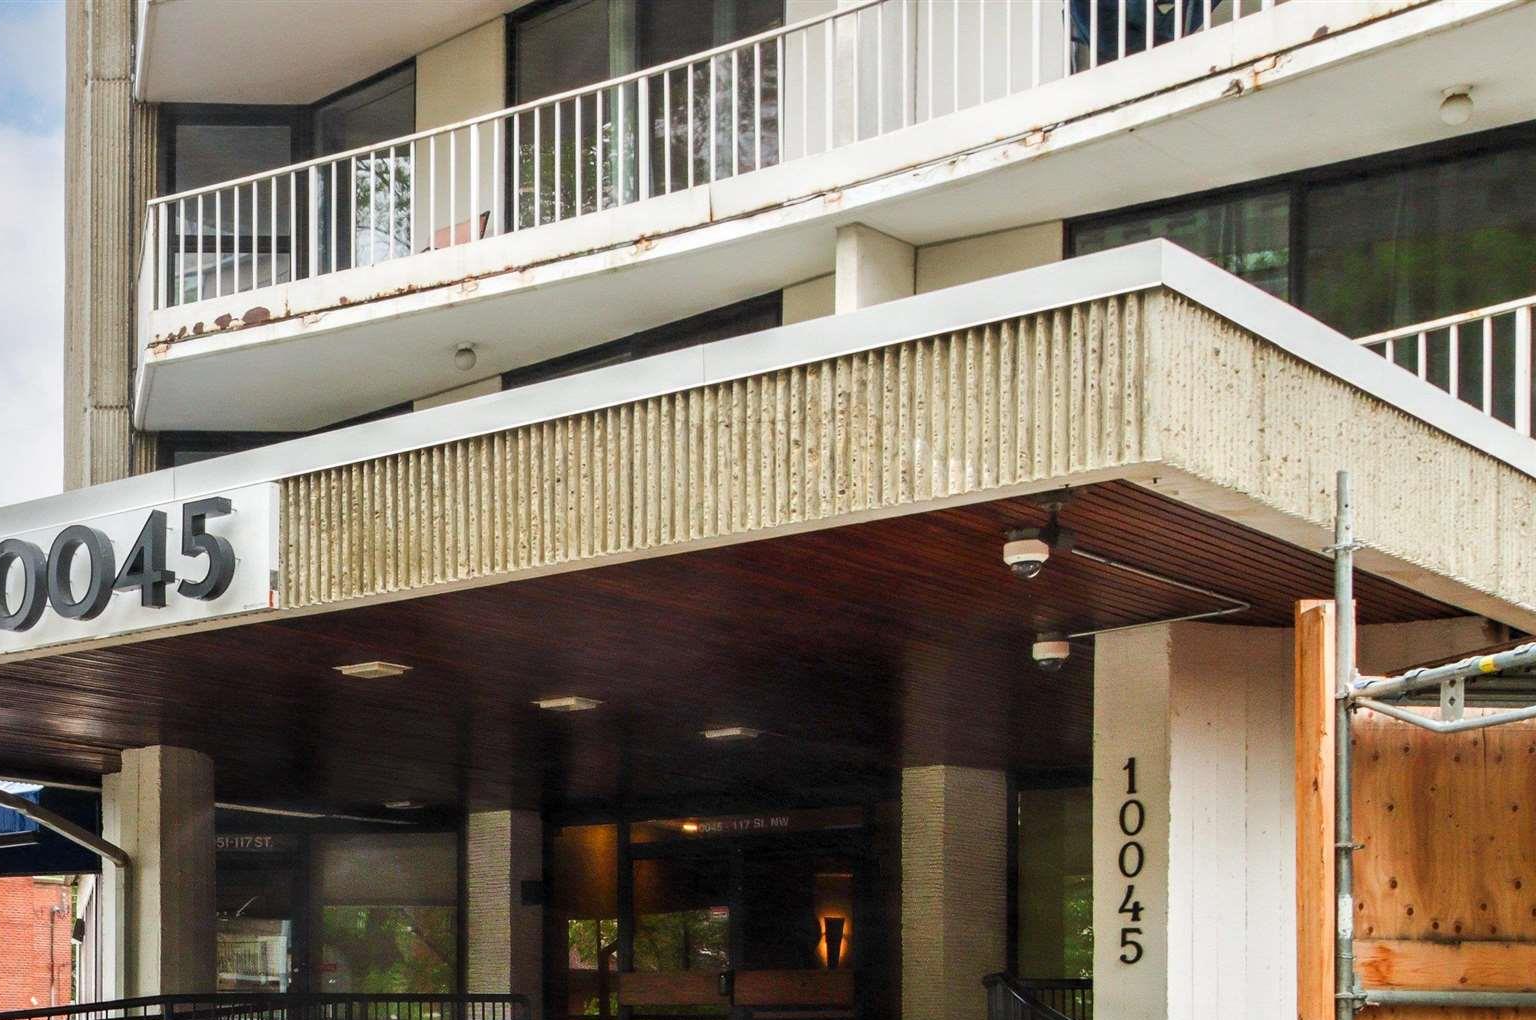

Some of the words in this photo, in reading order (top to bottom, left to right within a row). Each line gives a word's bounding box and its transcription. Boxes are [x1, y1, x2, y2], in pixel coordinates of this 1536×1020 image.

[694, 822, 722, 833] 0045
[732, 820, 751, 831] 117
[769, 817, 789, 828] NW
[1118, 757, 1145, 965] 10045
